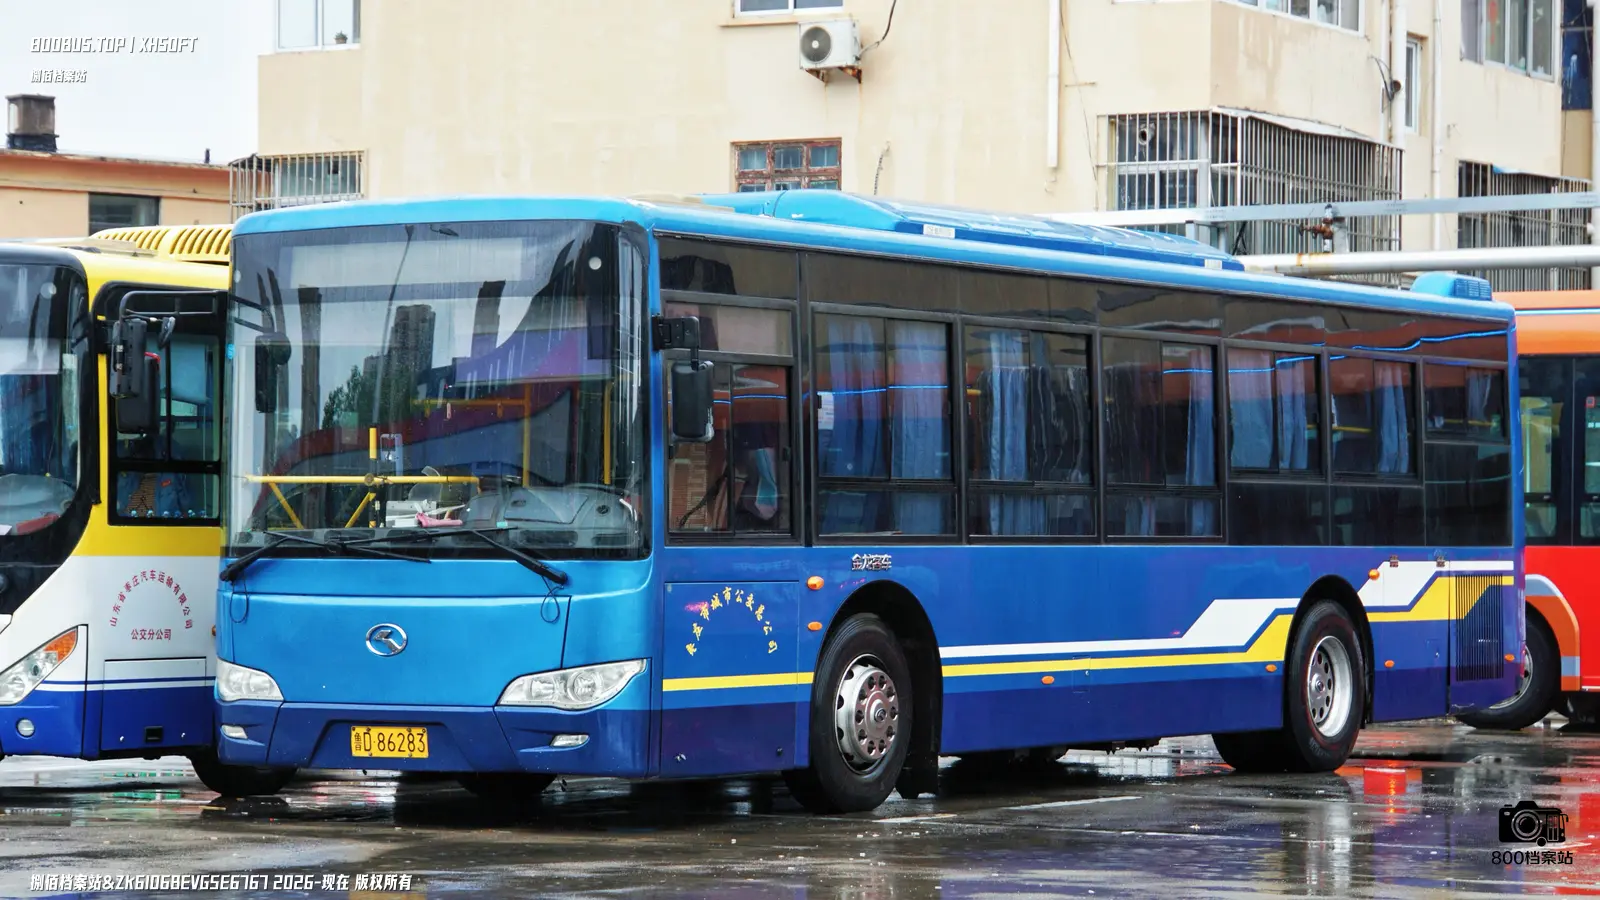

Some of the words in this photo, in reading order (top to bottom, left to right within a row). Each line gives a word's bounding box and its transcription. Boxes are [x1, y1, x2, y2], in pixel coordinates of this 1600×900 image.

[852, 553, 892, 571] 金龙客车
[109, 569, 193, 629] 山东省枣庄汽车运输有限公司
[131, 628, 172, 641] 公交分公司
